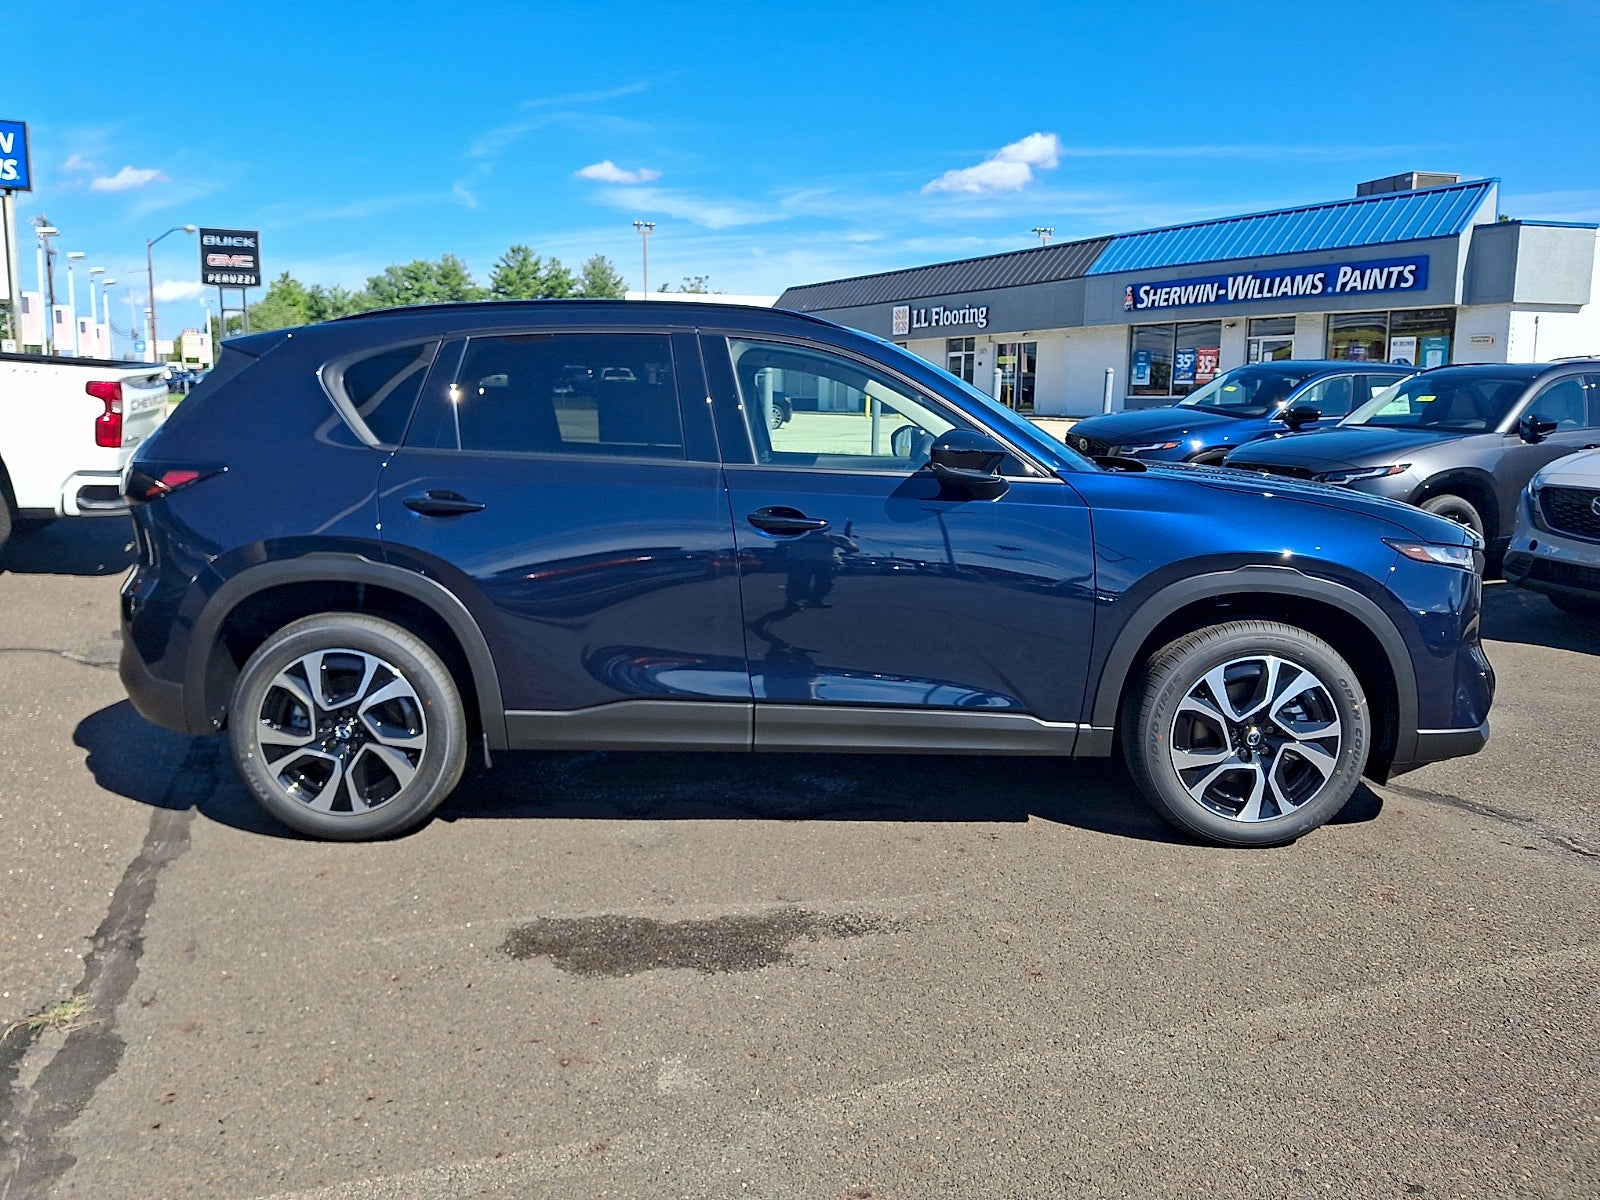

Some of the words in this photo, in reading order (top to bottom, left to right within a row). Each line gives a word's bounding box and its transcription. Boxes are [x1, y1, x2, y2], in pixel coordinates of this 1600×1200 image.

[0, 158, 18, 181] S
[202, 234, 256, 248] BUICK
[206, 253, 254, 268] GMC
[207, 273, 256, 285] PERUZZI
[1136, 273, 1325, 309] SHERWIN-WILLIAMS
[1335, 264, 1416, 293] PAINTS
[912, 308, 928, 329] LL
[931, 304, 988, 329] Flooring
[1338, 678, 1361, 721] OPEN
